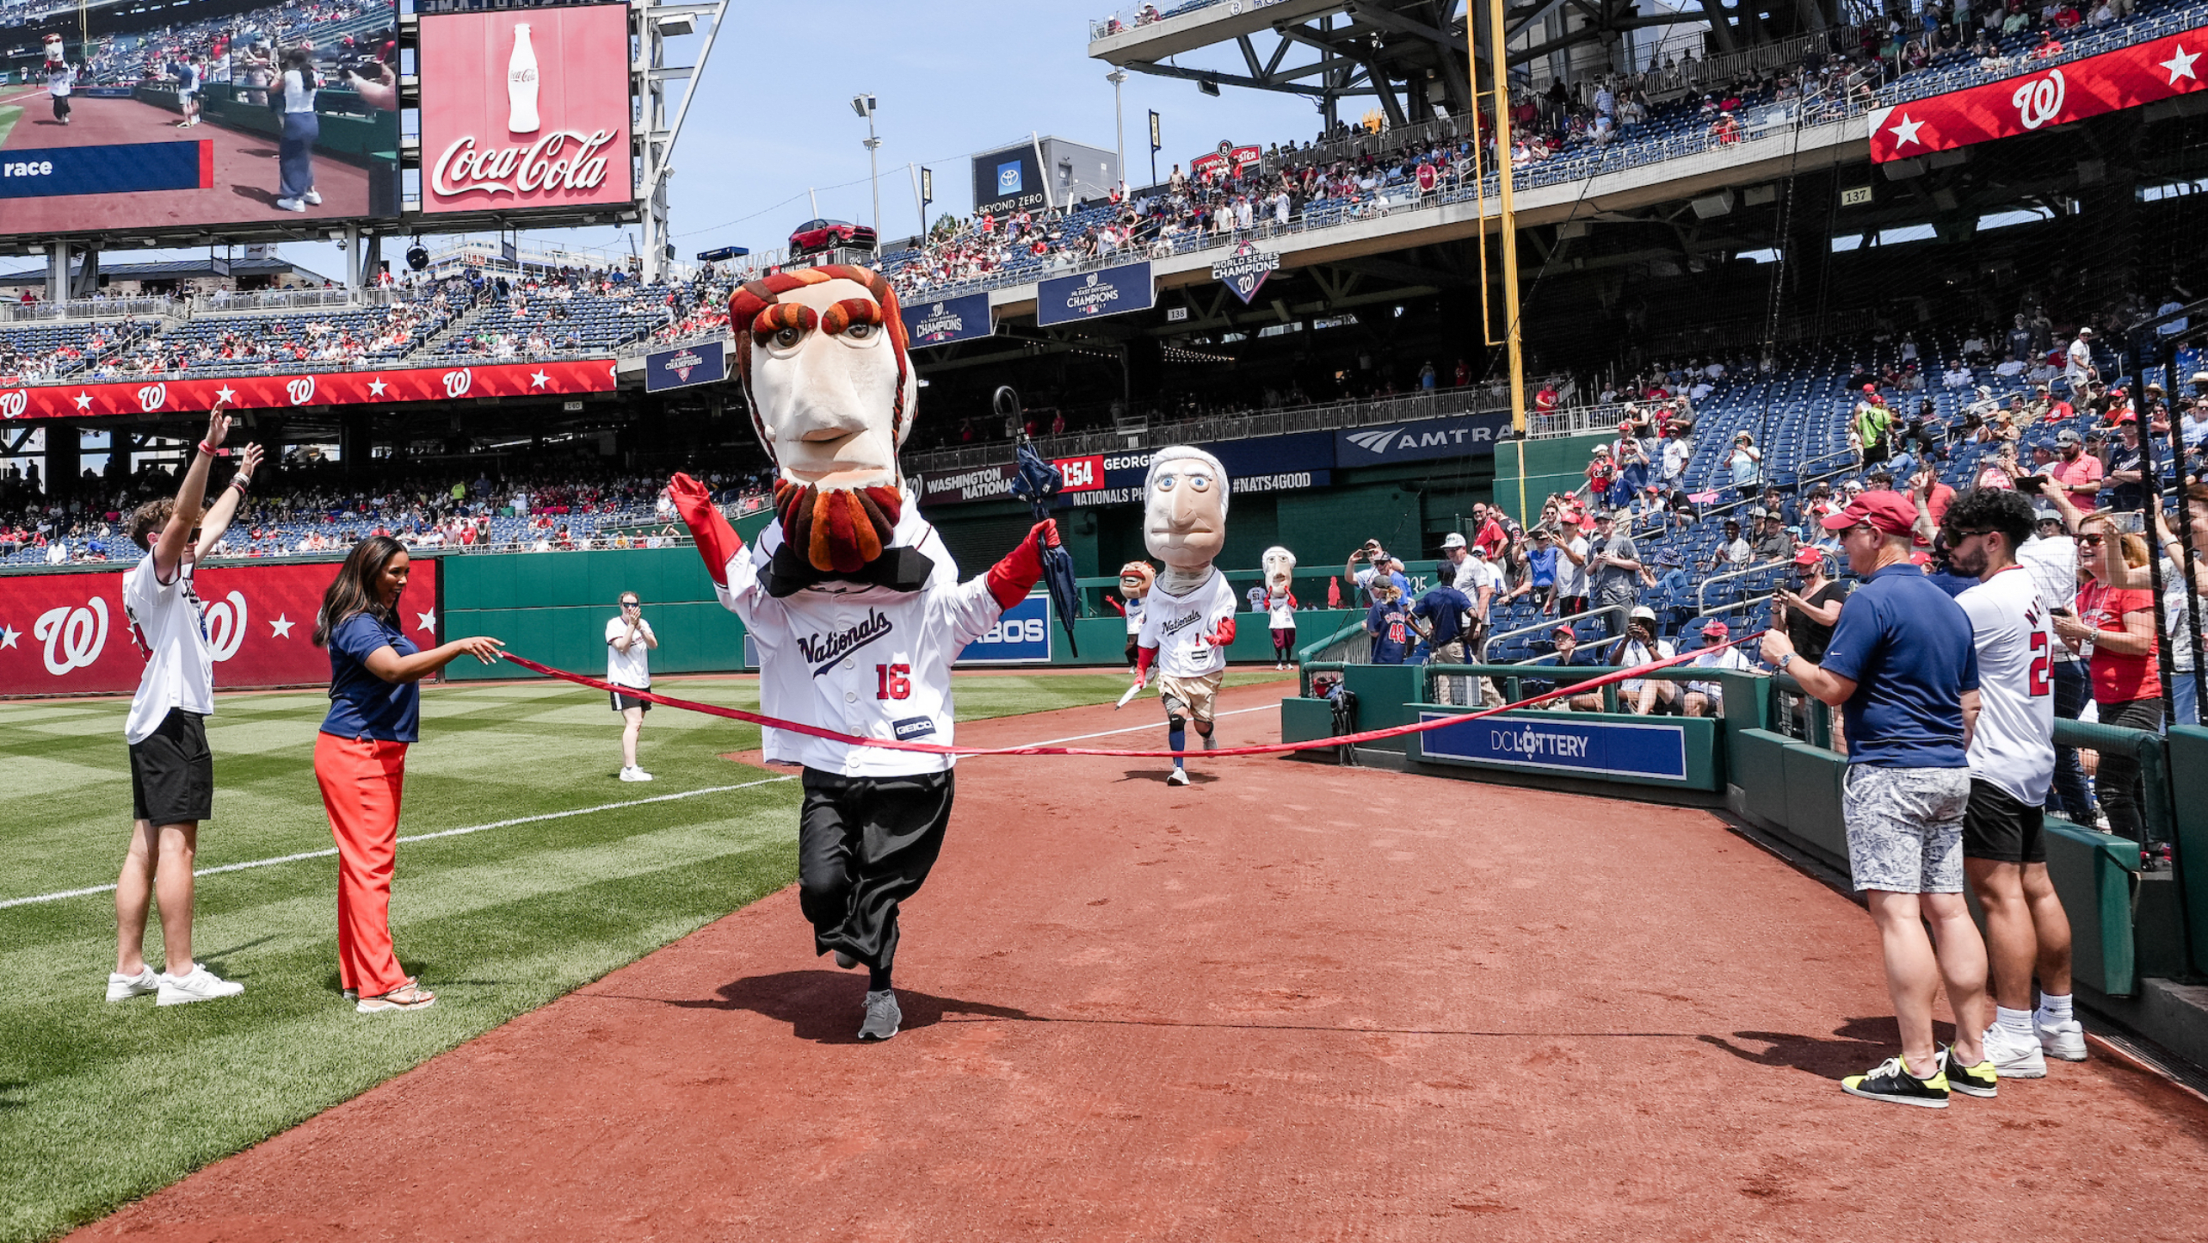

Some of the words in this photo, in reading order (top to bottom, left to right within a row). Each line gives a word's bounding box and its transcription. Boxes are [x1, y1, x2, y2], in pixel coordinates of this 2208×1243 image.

[2012, 69, 2065, 130] W
[4, 160, 53, 177] race
[431, 128, 619, 196] Coca-Cola
[979, 199, 1016, 215] BEYOND
[1018, 193, 1043, 207] ZERO
[1846, 190, 1867, 203] 137
[1212, 257, 1244, 269] WORLD
[1247, 251, 1279, 262] SERIES
[1212, 260, 1280, 279] CHAMPIONS
[1067, 290, 1119, 308] CHAMPIONS
[1171, 310, 1185, 319] 138
[917, 318, 962, 338] CHAMPIONS
[665, 357, 703, 370] CHAMPIONS
[287, 375, 315, 405] W
[442, 368, 471, 398] W
[138, 382, 166, 412] W
[927, 467, 1001, 494] WASHINGTON
[1062, 460, 1093, 487] 1:54
[1232, 472, 1311, 493] #NATS4GOOD
[1073, 488, 1129, 506] NATIONALS
[1161, 609, 1202, 635] Nationals
[1389, 622, 1406, 644] 48
[34, 596, 109, 676] W
[796, 606, 893, 674] Nationals
[1195, 632, 1201, 647] 1
[876, 663, 911, 699] 16
[896, 720, 933, 735] GEICO
